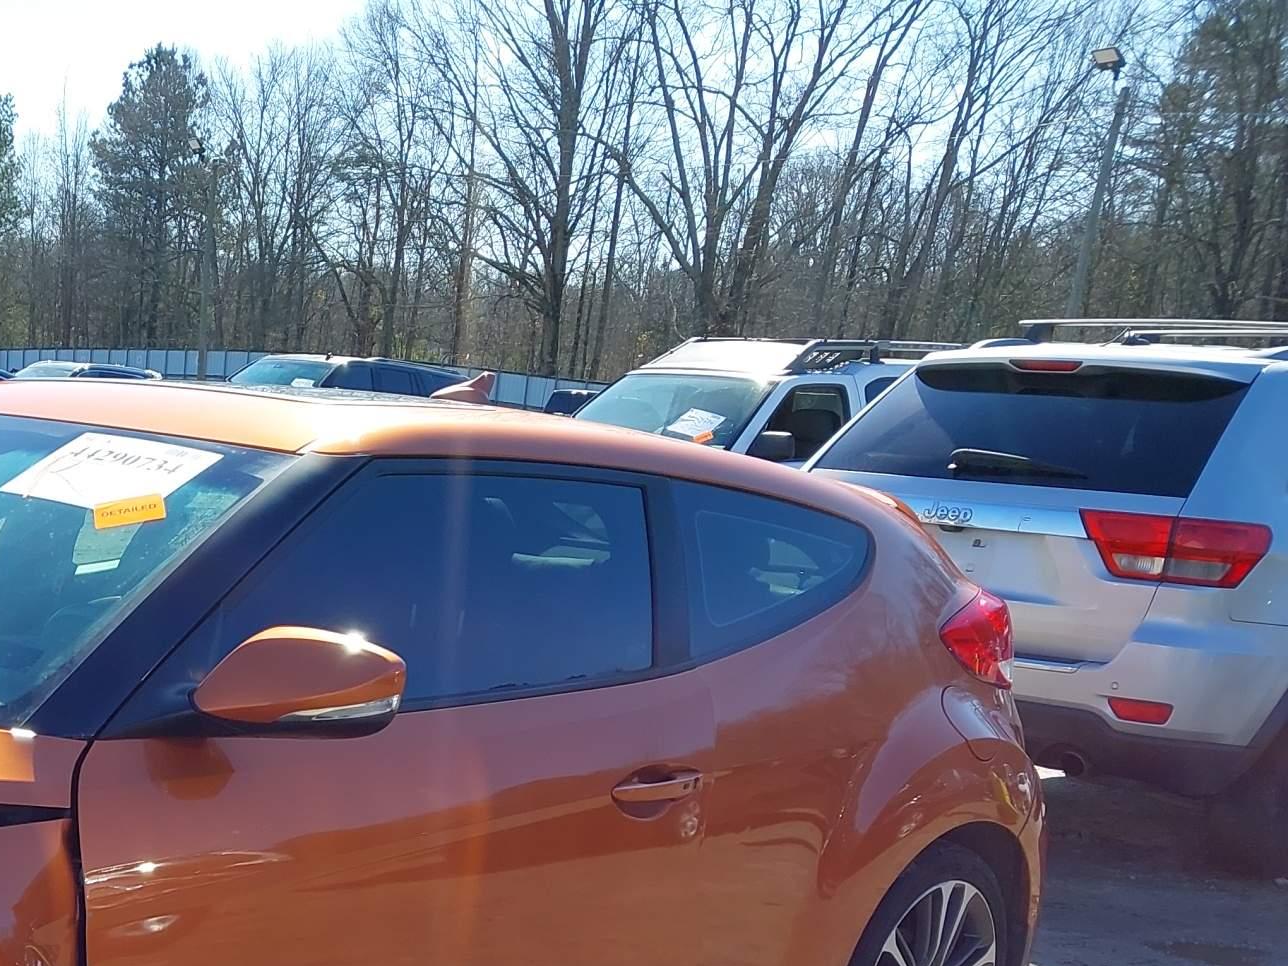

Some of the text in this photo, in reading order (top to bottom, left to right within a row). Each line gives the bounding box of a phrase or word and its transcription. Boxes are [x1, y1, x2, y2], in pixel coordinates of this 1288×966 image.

[69, 447, 184, 474] 44290734
[100, 503, 158, 518] DETAILED
[923, 501, 974, 524] Jeep
